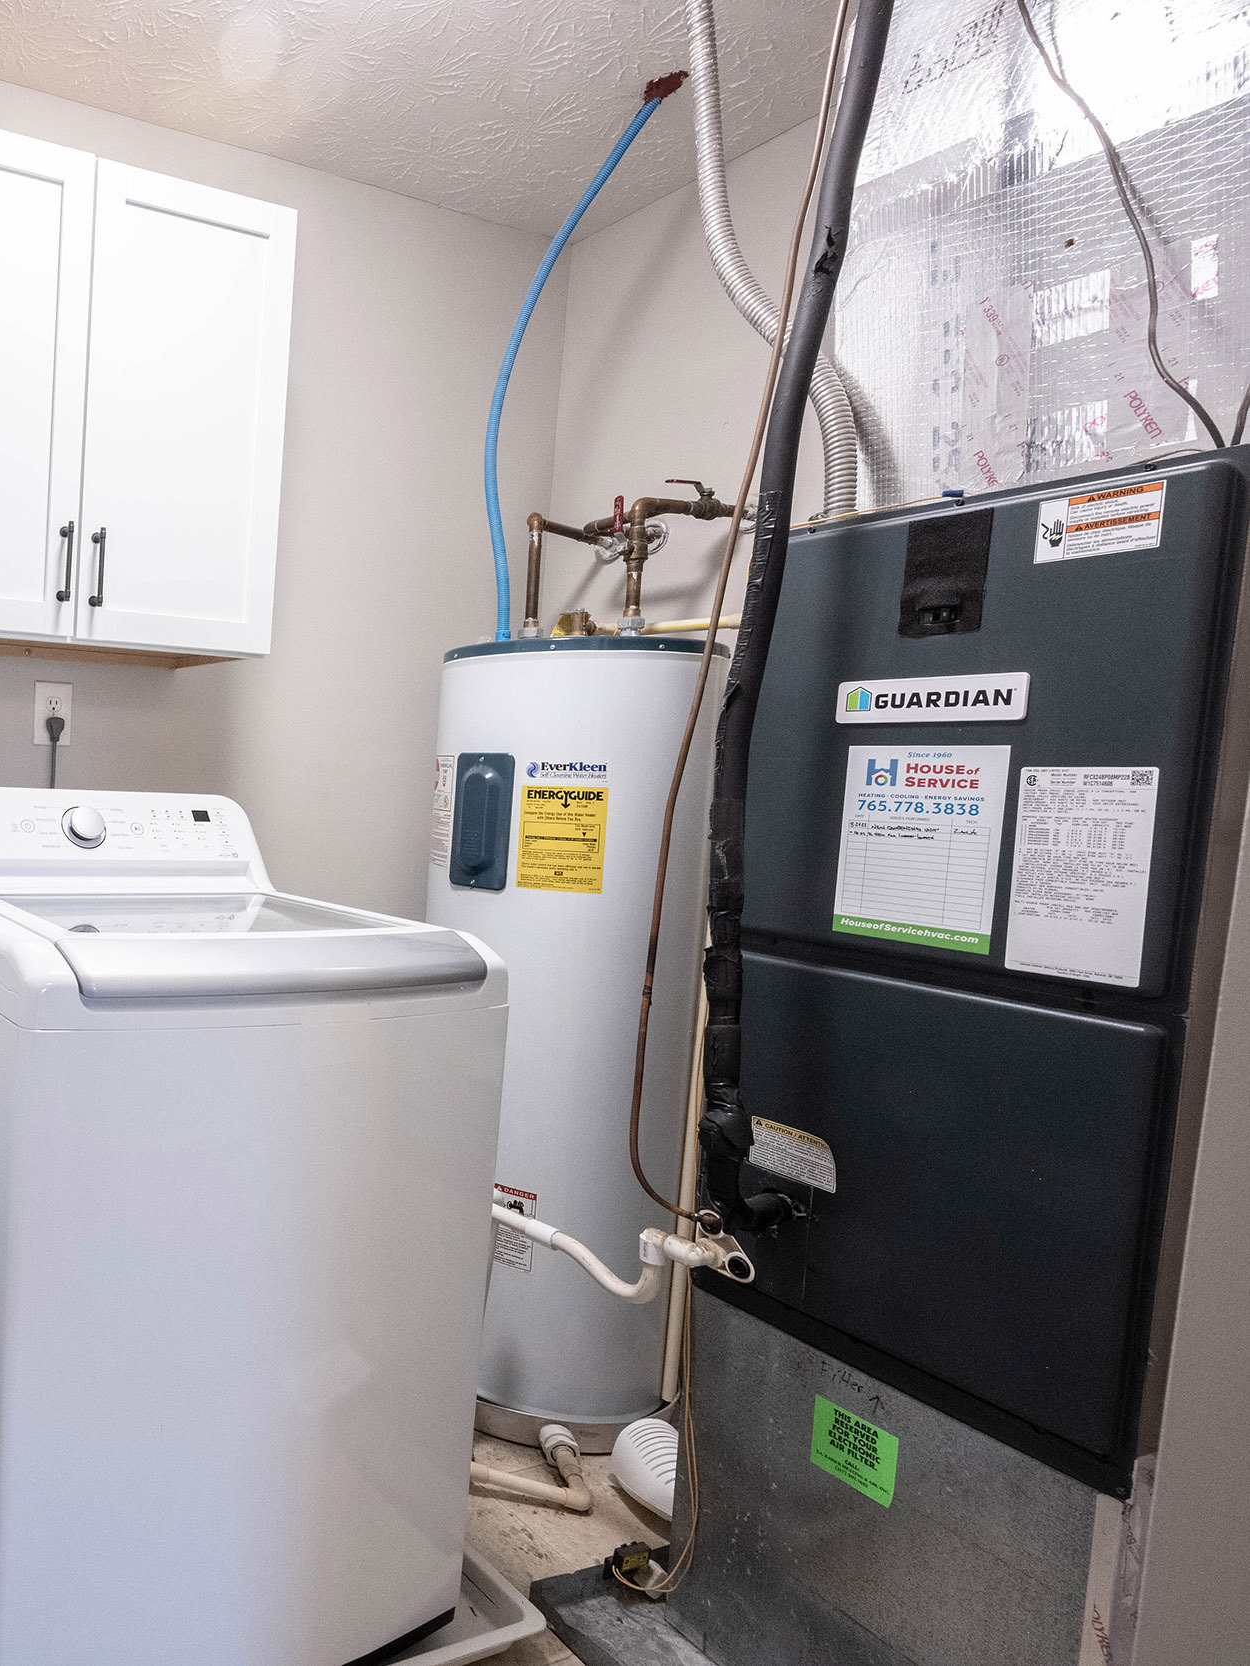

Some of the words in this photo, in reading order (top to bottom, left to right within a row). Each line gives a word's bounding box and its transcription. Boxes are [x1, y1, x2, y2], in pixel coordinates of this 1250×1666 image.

[1114, 372, 1125, 382] 21
[1123, 390, 1164, 439] POLYKEN
[1097, 486, 1144, 500] WARNING
[1084, 513, 1152, 530] AVERTISSEMENT
[874, 689, 1012, 709] GUARDIAN
[541, 762, 607, 772] EverKleen
[906, 763, 965, 775] HOUSE
[966, 767, 981, 775] of
[905, 777, 979, 789] SERVICE
[527, 790, 604, 802] ENERGYGUIDE
[858, 800, 980, 816] 765.778.3838
[840, 917, 979, 944] HouseofServicehvac.com
[765, 1123, 793, 1137] CAUTION
[504, 1188, 535, 1200] DANGER
[833, 1408, 851, 1423] THIS
[854, 1420, 879, 1439] AREA
[834, 1418, 877, 1445] RESERVED
[828, 1430, 881, 1465] ELECTRONIC
[832, 1424, 850, 1440] FOR
[852, 1437, 878, 1455] YOUR
[830, 1439, 845, 1453] AIR
[847, 1449, 878, 1471] FILTER.
[844, 1459, 861, 1471] CALL:
